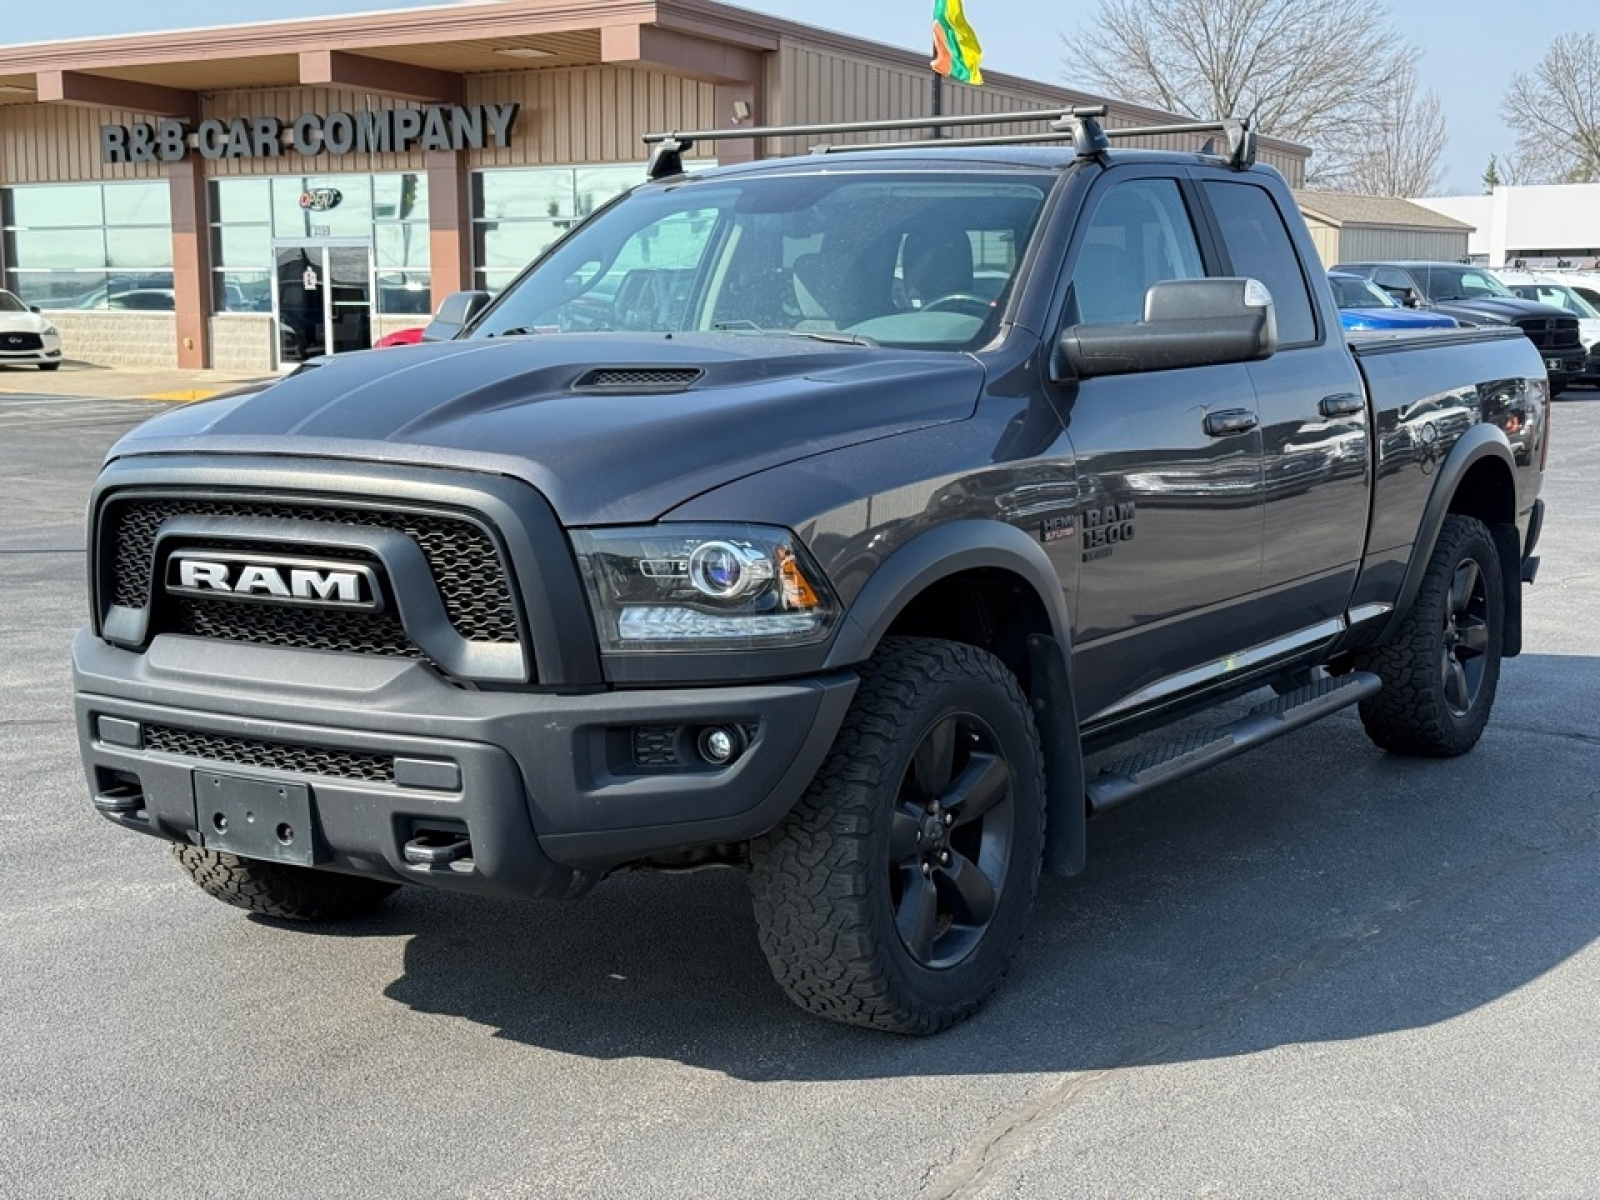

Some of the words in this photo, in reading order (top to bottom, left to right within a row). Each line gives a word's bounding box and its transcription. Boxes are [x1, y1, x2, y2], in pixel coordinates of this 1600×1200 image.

[101, 121, 188, 163] R&B
[199, 118, 282, 160] CAR
[294, 103, 518, 155] COMPANY
[1082, 502, 1135, 528] RAM
[1083, 523, 1134, 549] 1500
[180, 559, 360, 601] RAM
